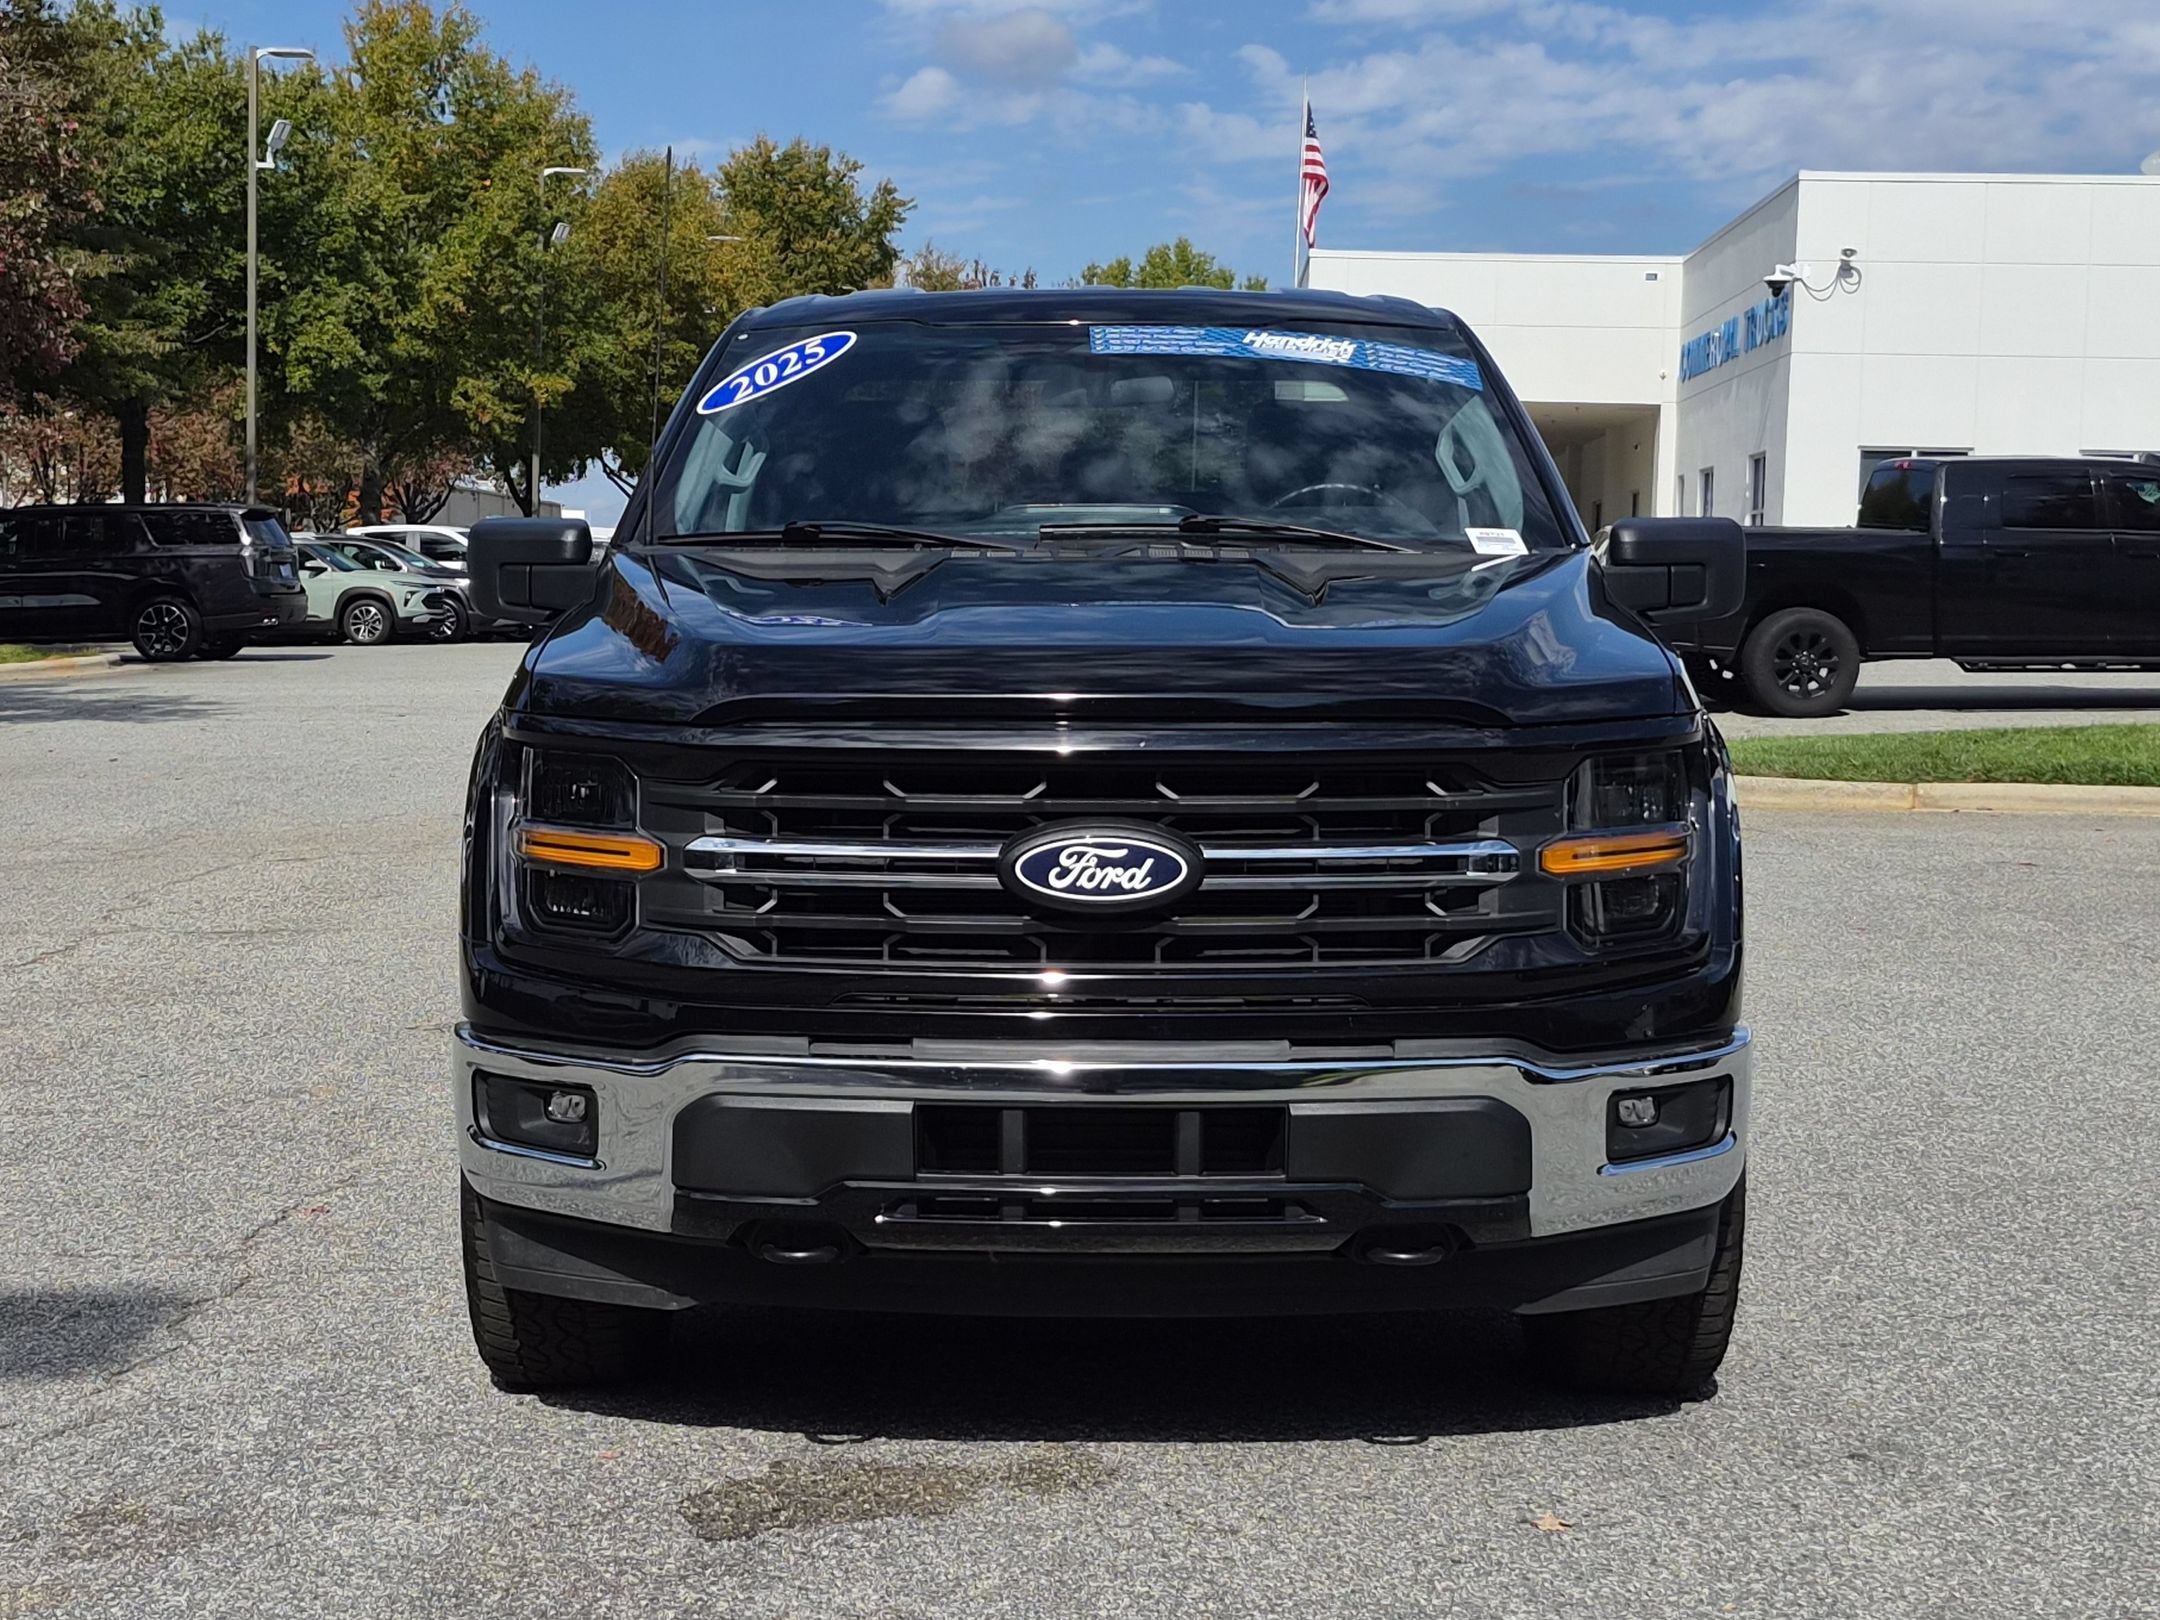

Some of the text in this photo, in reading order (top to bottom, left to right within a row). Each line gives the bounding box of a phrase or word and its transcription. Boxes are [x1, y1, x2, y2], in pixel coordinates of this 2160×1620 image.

[1242, 331, 1357, 355] Hendrick
[1743, 289, 1790, 353] TRUCKS
[729, 338, 826, 403] 2025
[1048, 845, 1155, 891] Ford
